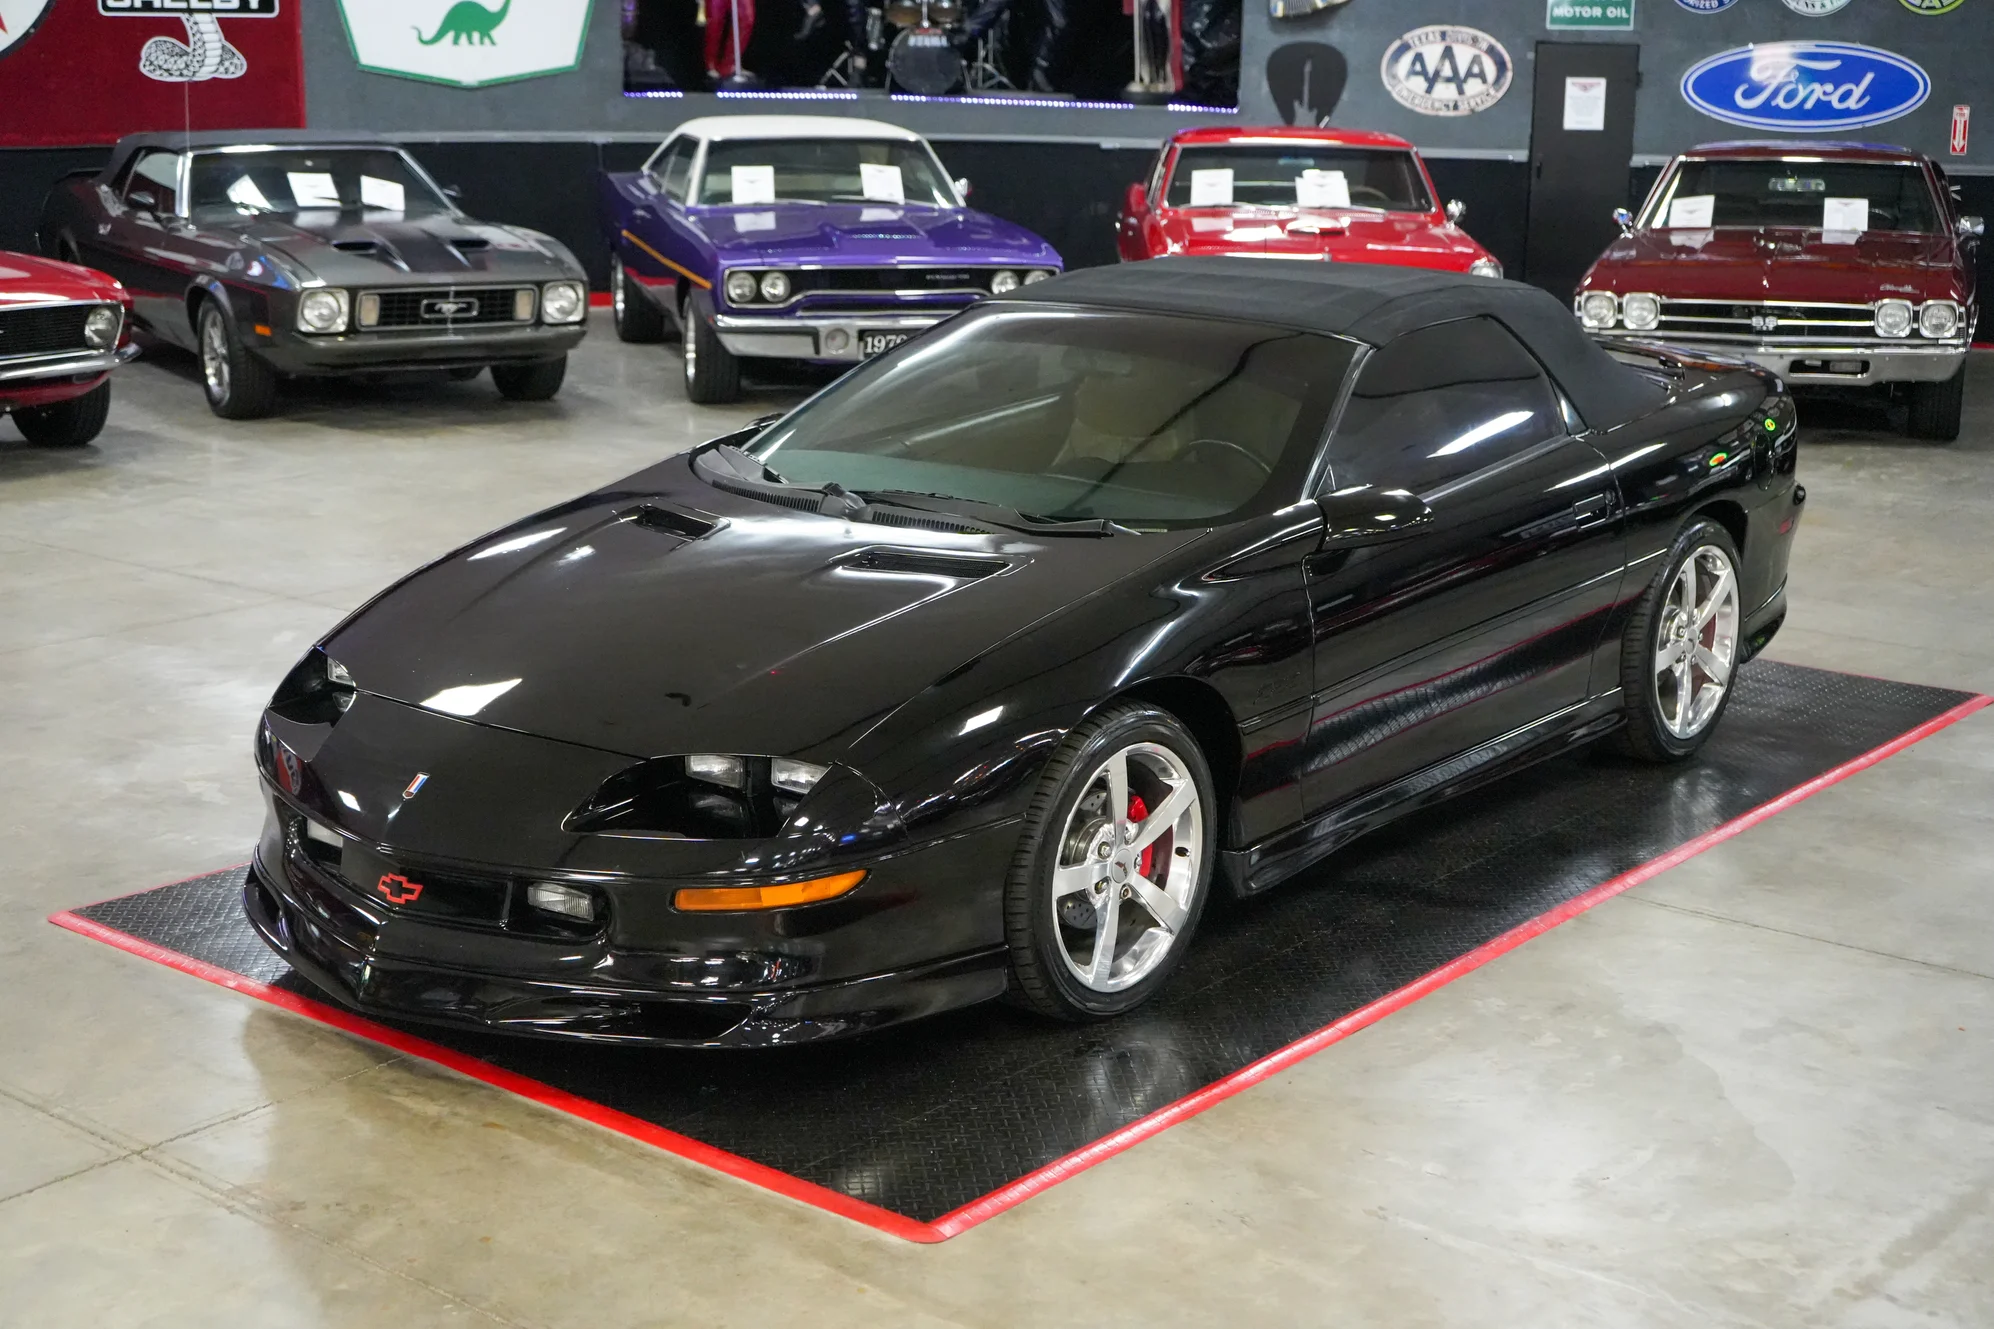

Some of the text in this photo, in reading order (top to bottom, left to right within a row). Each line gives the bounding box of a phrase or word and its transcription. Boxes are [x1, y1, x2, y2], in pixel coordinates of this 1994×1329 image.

[1552, 5, 1629, 18] MOTOR OIL
[1406, 45, 1488, 95] AAA
[1734, 58, 1875, 109] Ford
